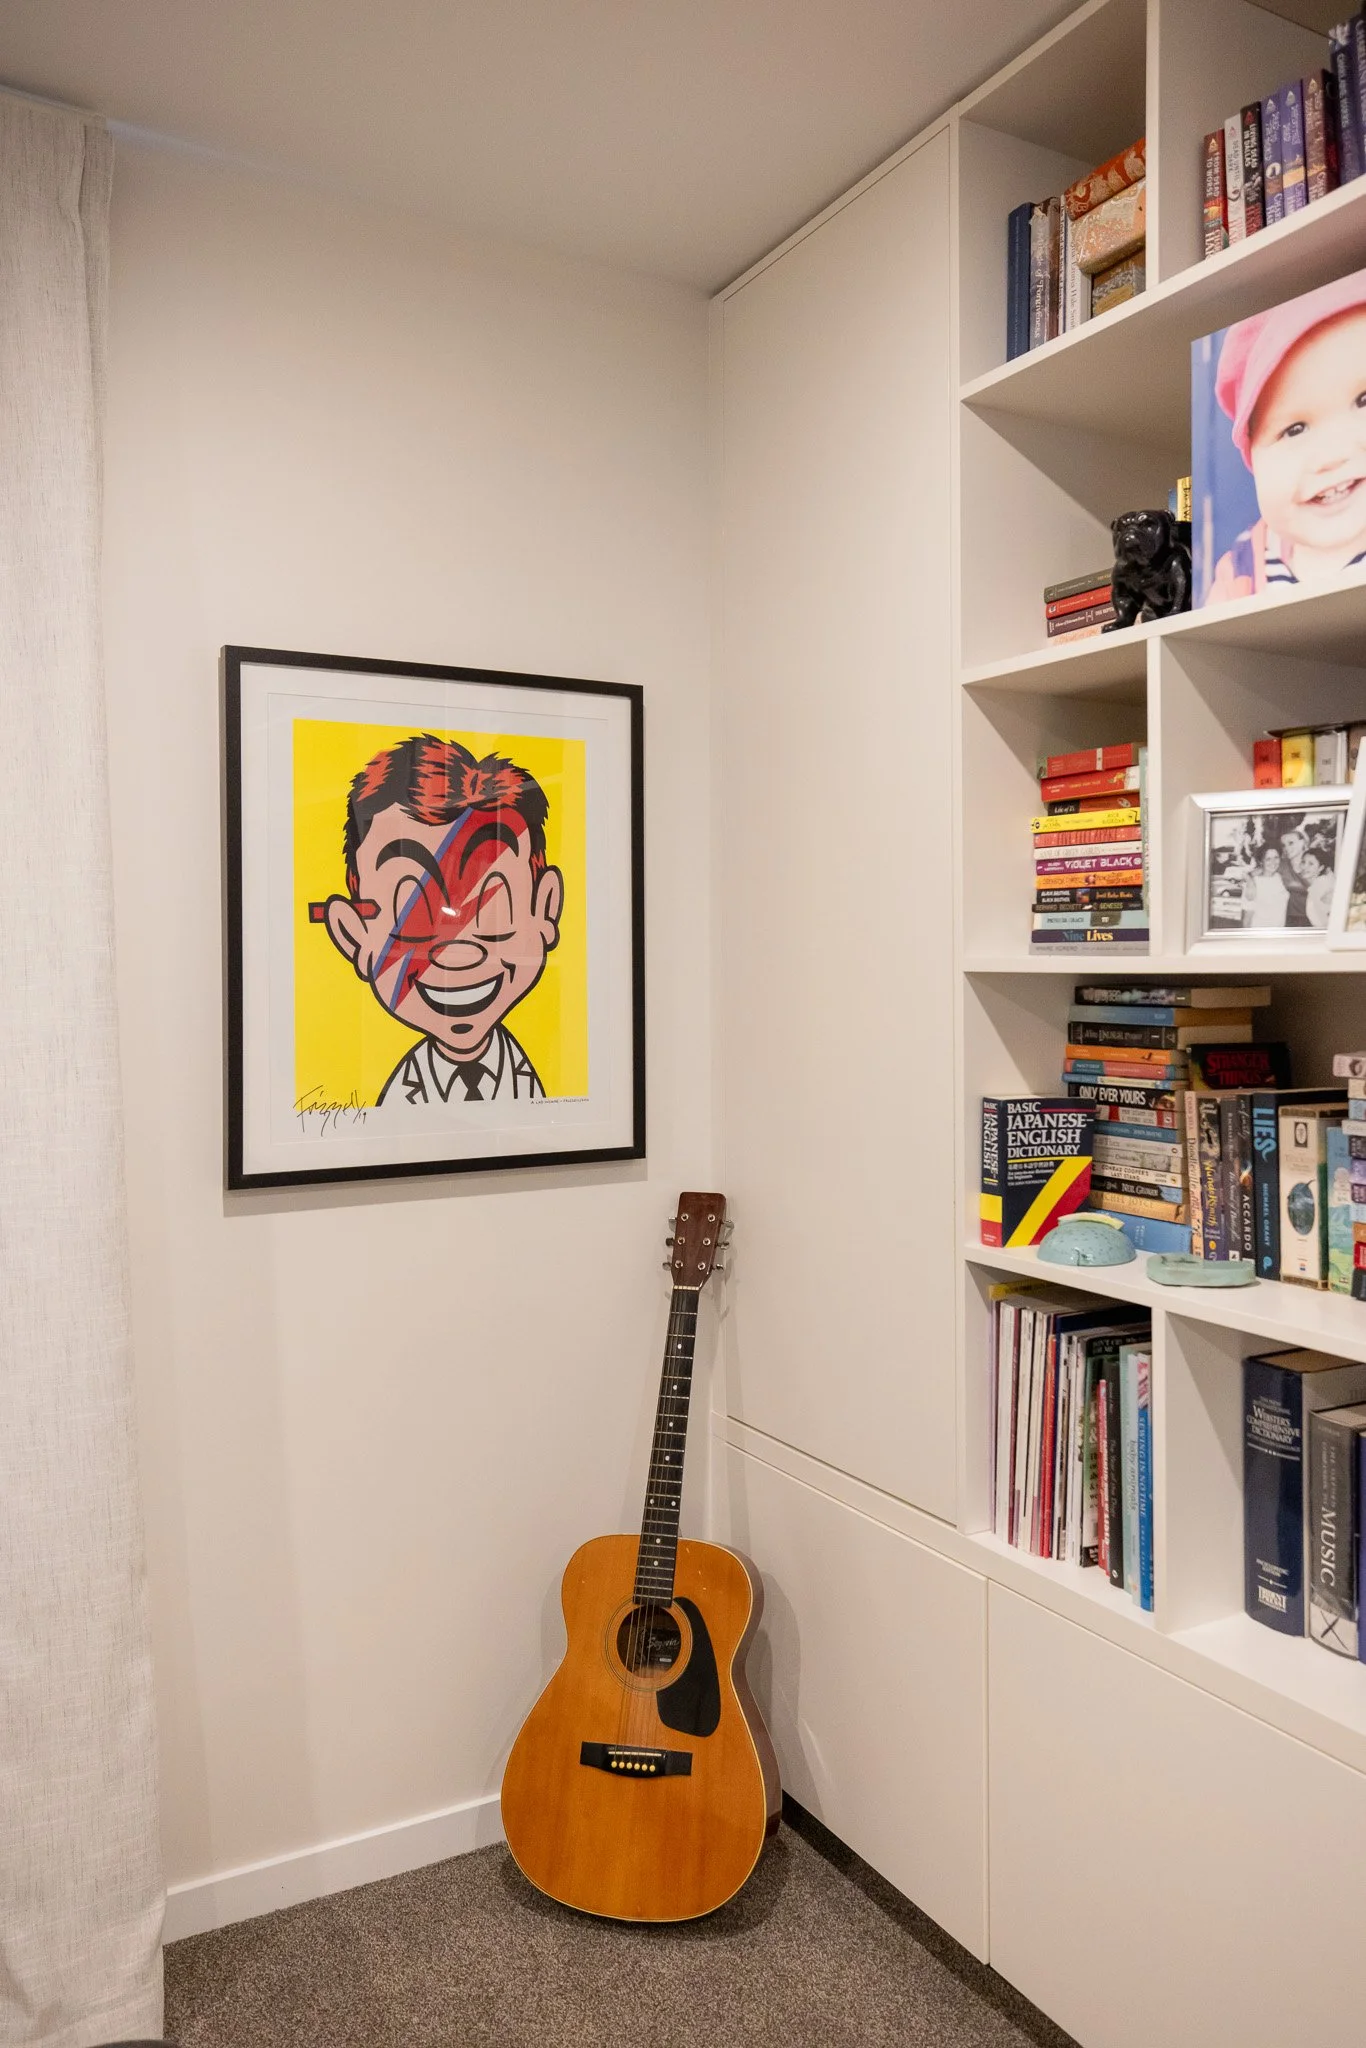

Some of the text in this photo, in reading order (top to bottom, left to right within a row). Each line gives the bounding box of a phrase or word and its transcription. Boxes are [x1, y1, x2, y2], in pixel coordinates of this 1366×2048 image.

[1243, 130, 1250, 138] IN
[1249, 124, 1257, 147] LIVING
[1232, 140, 1240, 159] DEAD
[1212, 152, 1220, 174] FROM
[1206, 158, 1214, 197] TO WORSE
[1034, 280, 1043, 338] Forgiveness
[1064, 859, 1097, 870] VIOLET
[1100, 856, 1132, 867] BLACK
[1062, 930, 1113, 942] Nine Lives
[1206, 1053, 1270, 1073] STRANGER
[1220, 1070, 1261, 1085] THINGS
[1080, 1086, 1146, 1105] ONLY EVER YOURS
[984, 1102, 998, 1110] BASIC
[1007, 1102, 1041, 1114] BASIC
[1006, 1113, 1094, 1131] JAPANESE-
[1007, 1129, 1082, 1146] ENGLISH
[1252, 1108, 1276, 1162] LIES
[990, 1114, 998, 1178] JAPANESE-
[1007, 1144, 1080, 1158] DICTIONARY
[1187, 1138, 1200, 1189] Doodleville
[1262, 1183, 1270, 1216] MICHAEL
[1242, 1194, 1252, 1252] ACCARDO
[1253, 1404, 1290, 1426] WEBSTER'S
[1246, 1414, 1300, 1437] COMPREHENSIVE
[1252, 1424, 1292, 1444] DICTIONARY
[1138, 1416, 1146, 1458] SEWING
[1139, 1460, 1146, 1472] IN
[1140, 1474, 1146, 1490] NO
[1320, 1506, 1336, 1587] MUSIC
